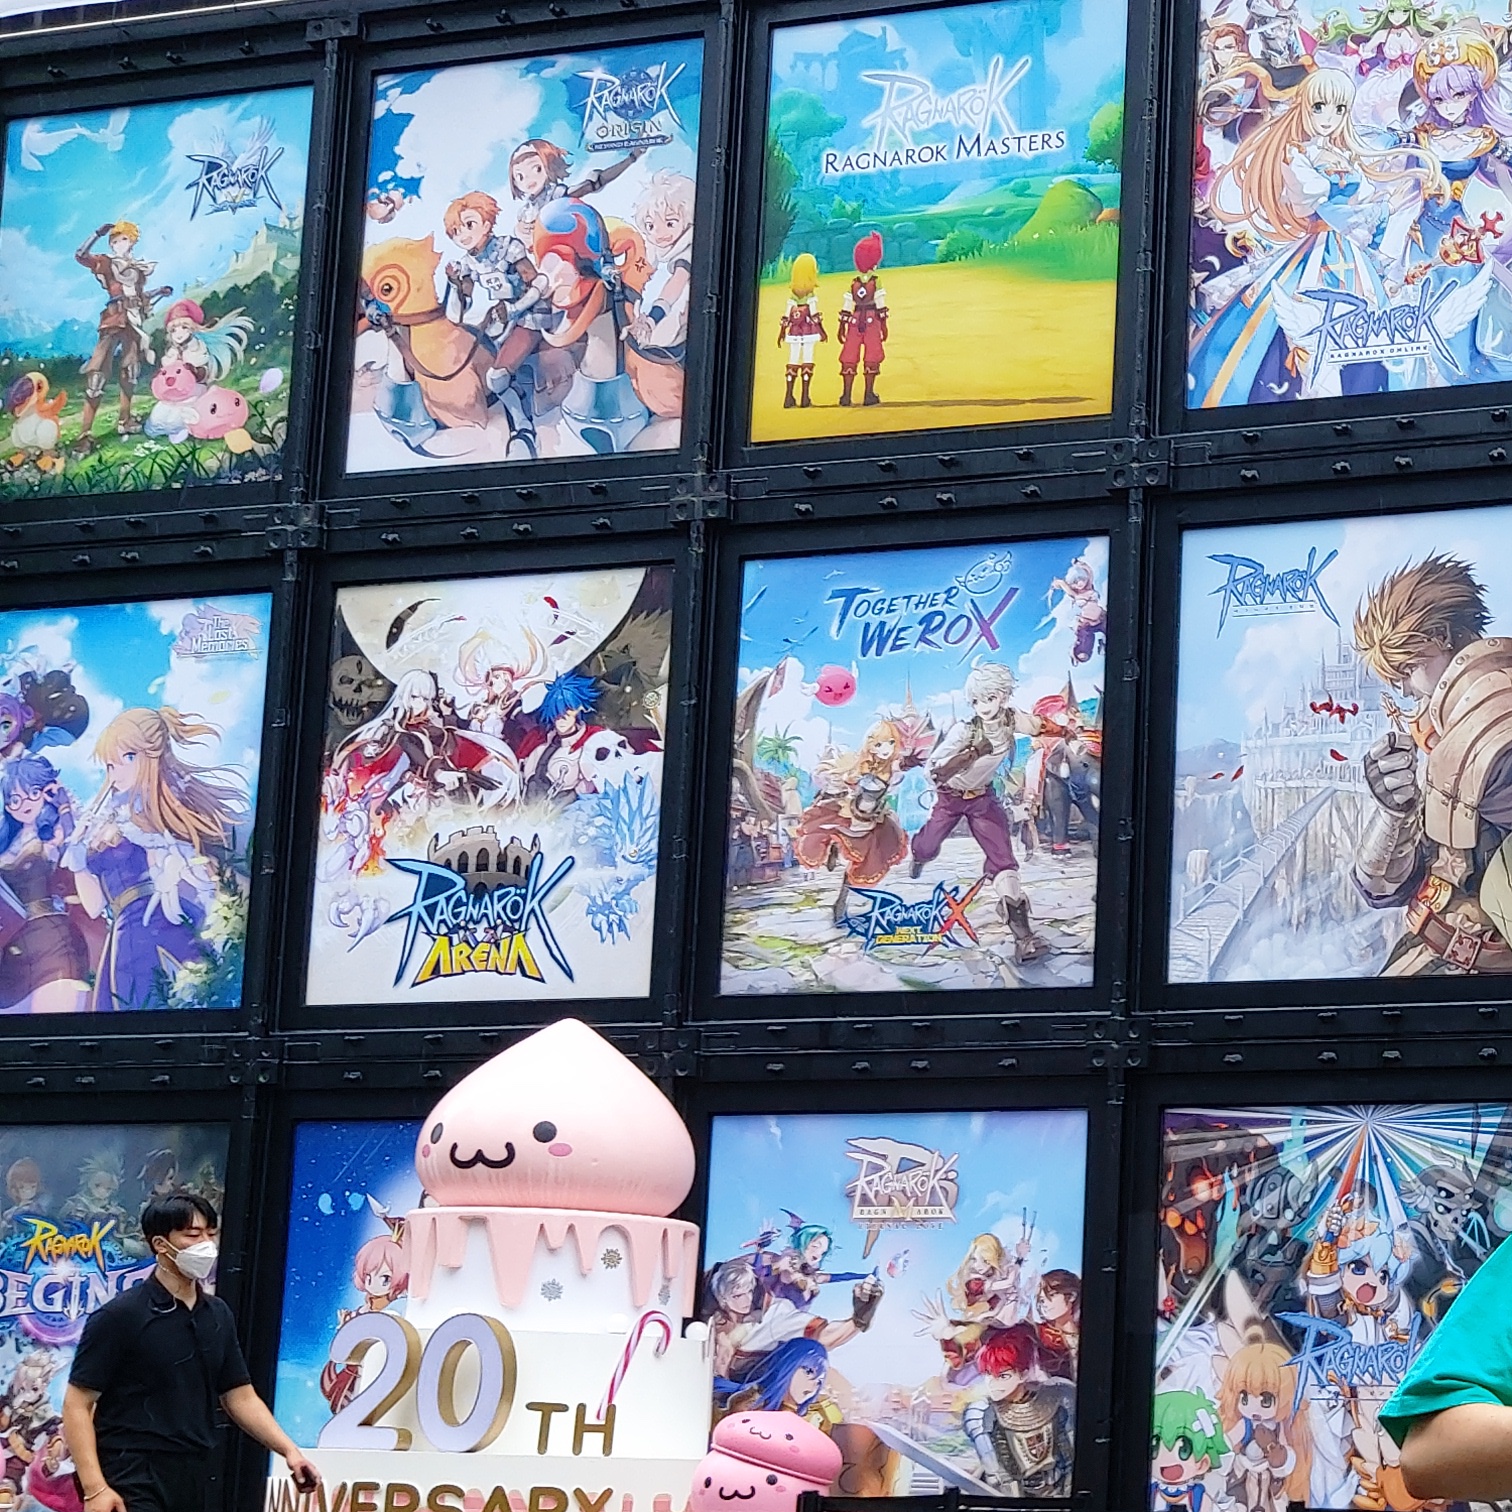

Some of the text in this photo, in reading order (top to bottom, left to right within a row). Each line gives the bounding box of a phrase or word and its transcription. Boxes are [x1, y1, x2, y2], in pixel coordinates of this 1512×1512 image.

[824, 131, 1066, 174] RAGNAROK MASTERS
[827, 585, 960, 638] TOGETHER
[409, 931, 547, 989] ARENA
